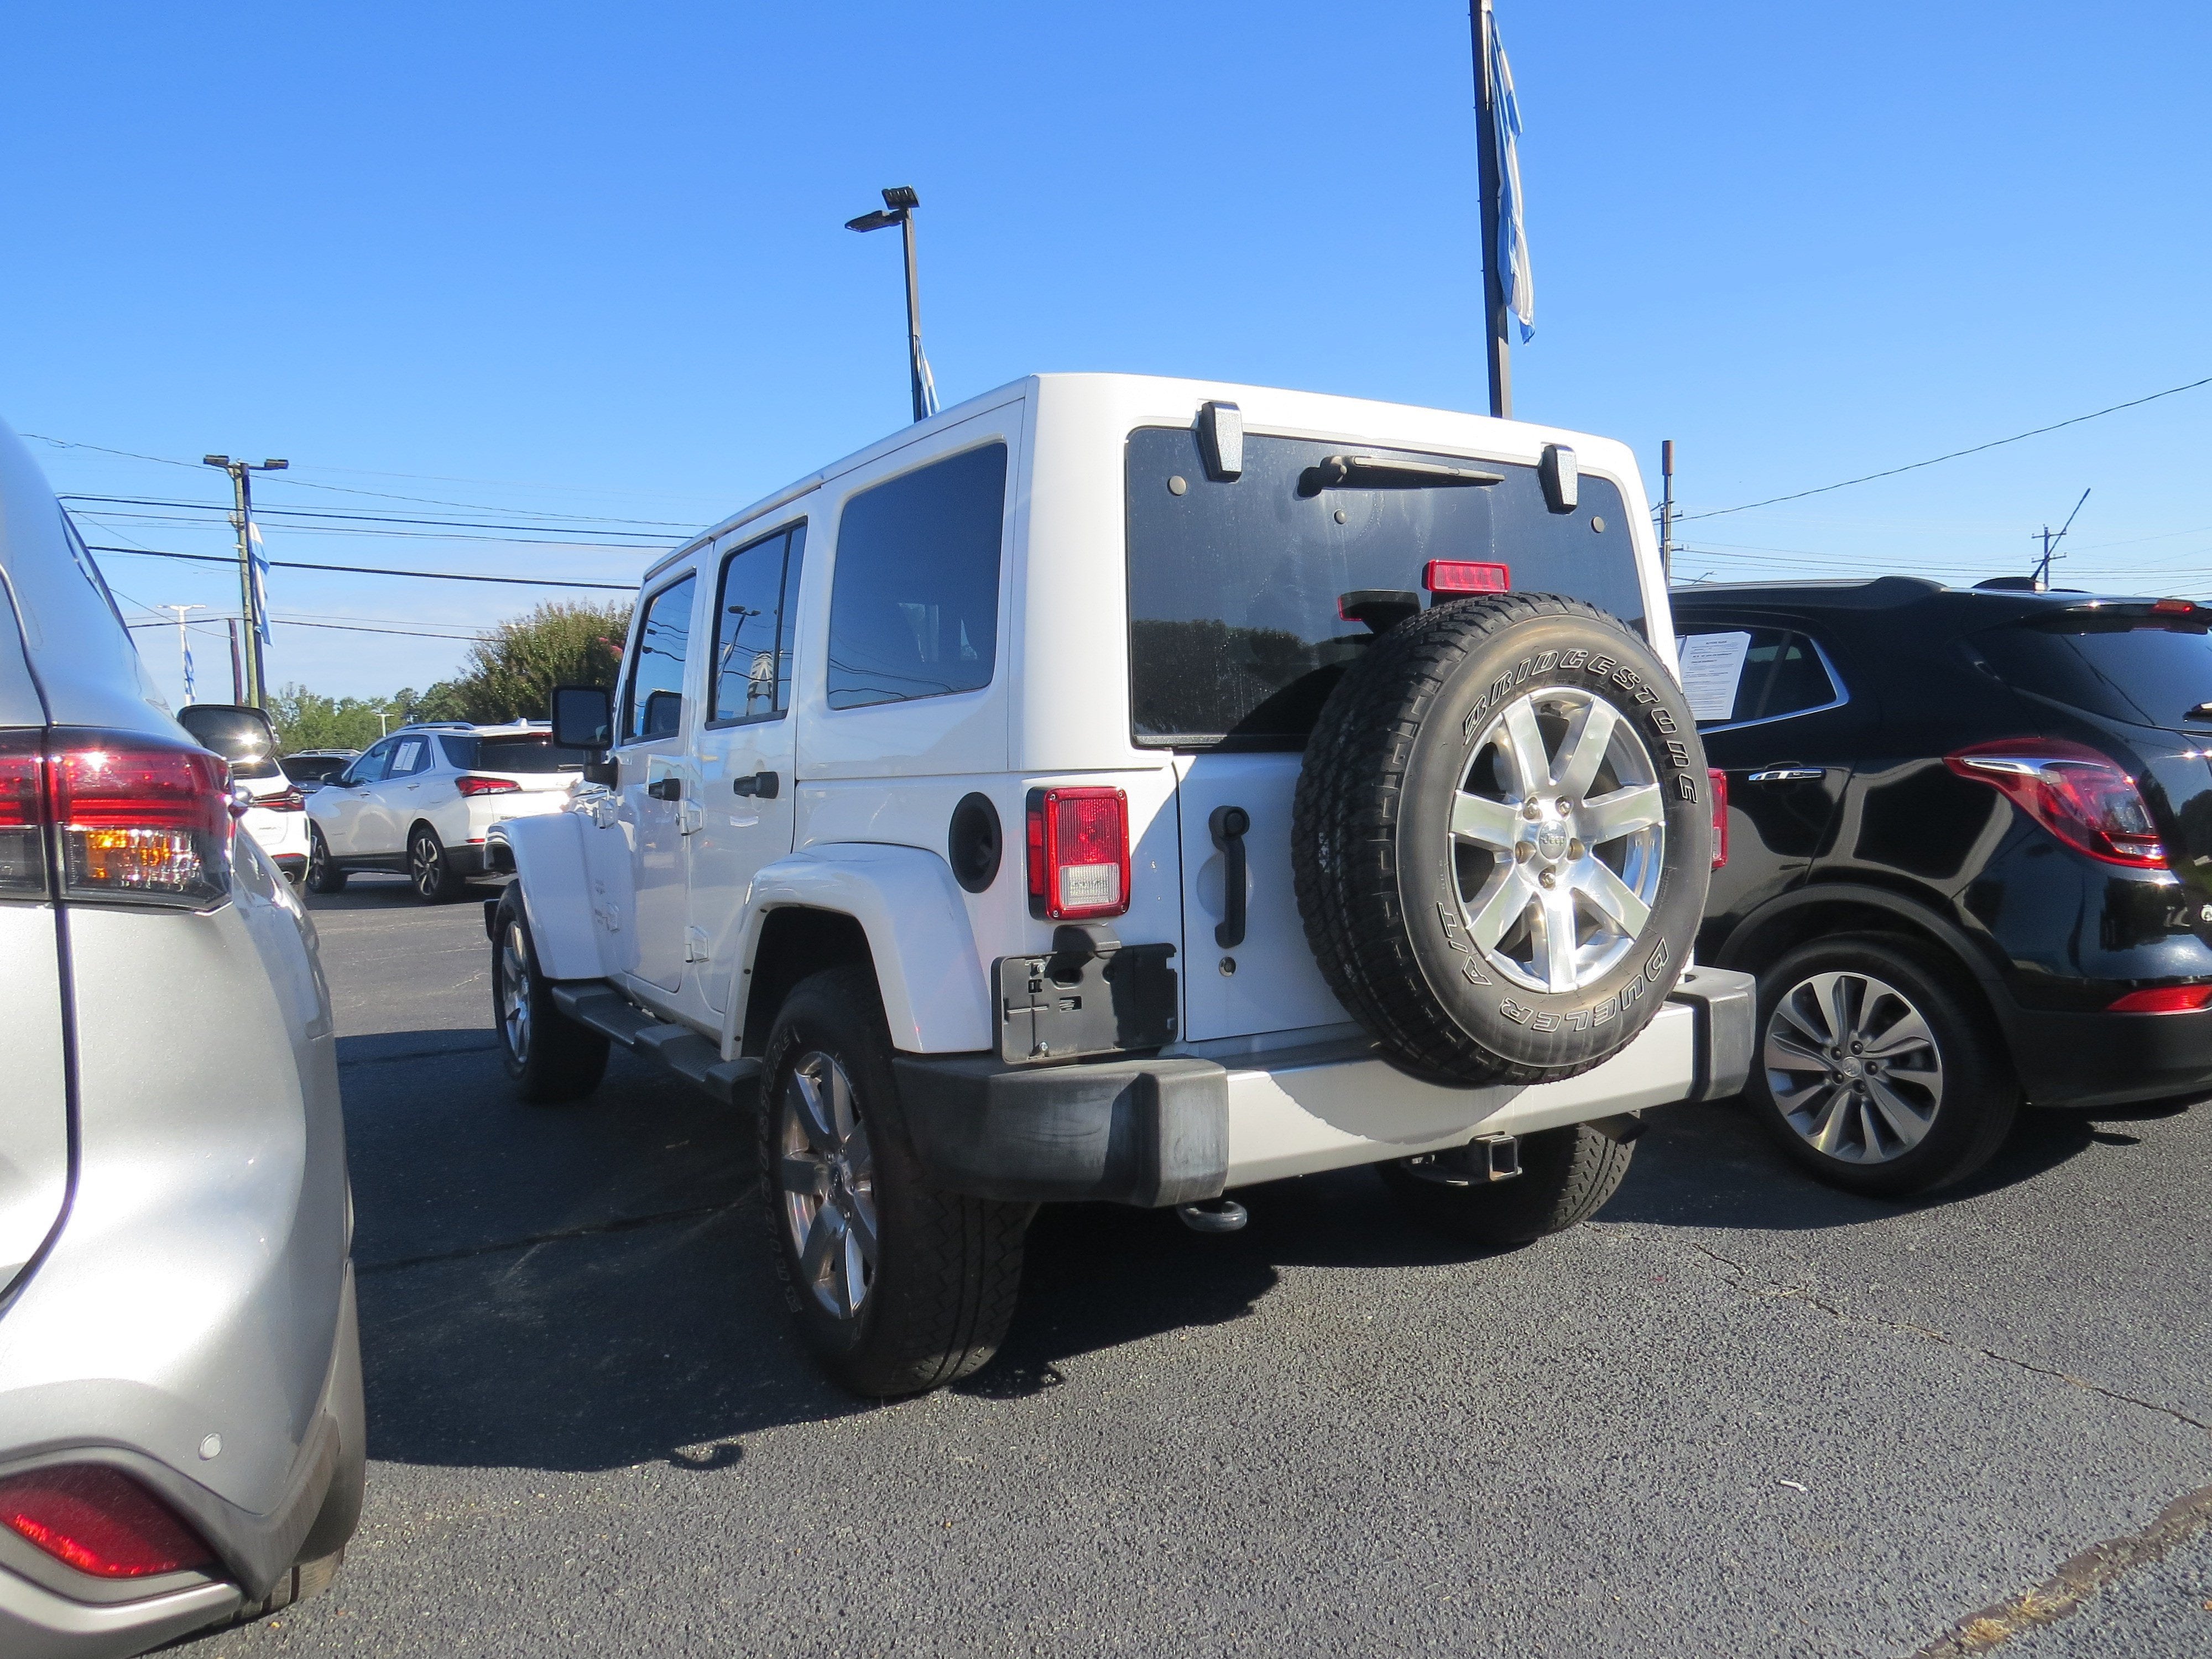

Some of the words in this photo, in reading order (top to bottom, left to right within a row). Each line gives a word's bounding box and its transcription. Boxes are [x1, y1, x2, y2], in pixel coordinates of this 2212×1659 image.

[1464, 649, 1698, 804] BRIDGESTONE
[1541, 833, 1564, 846] Jeep
[1437, 901, 1493, 986] A/T
[1500, 937, 1670, 1032] DUELER
